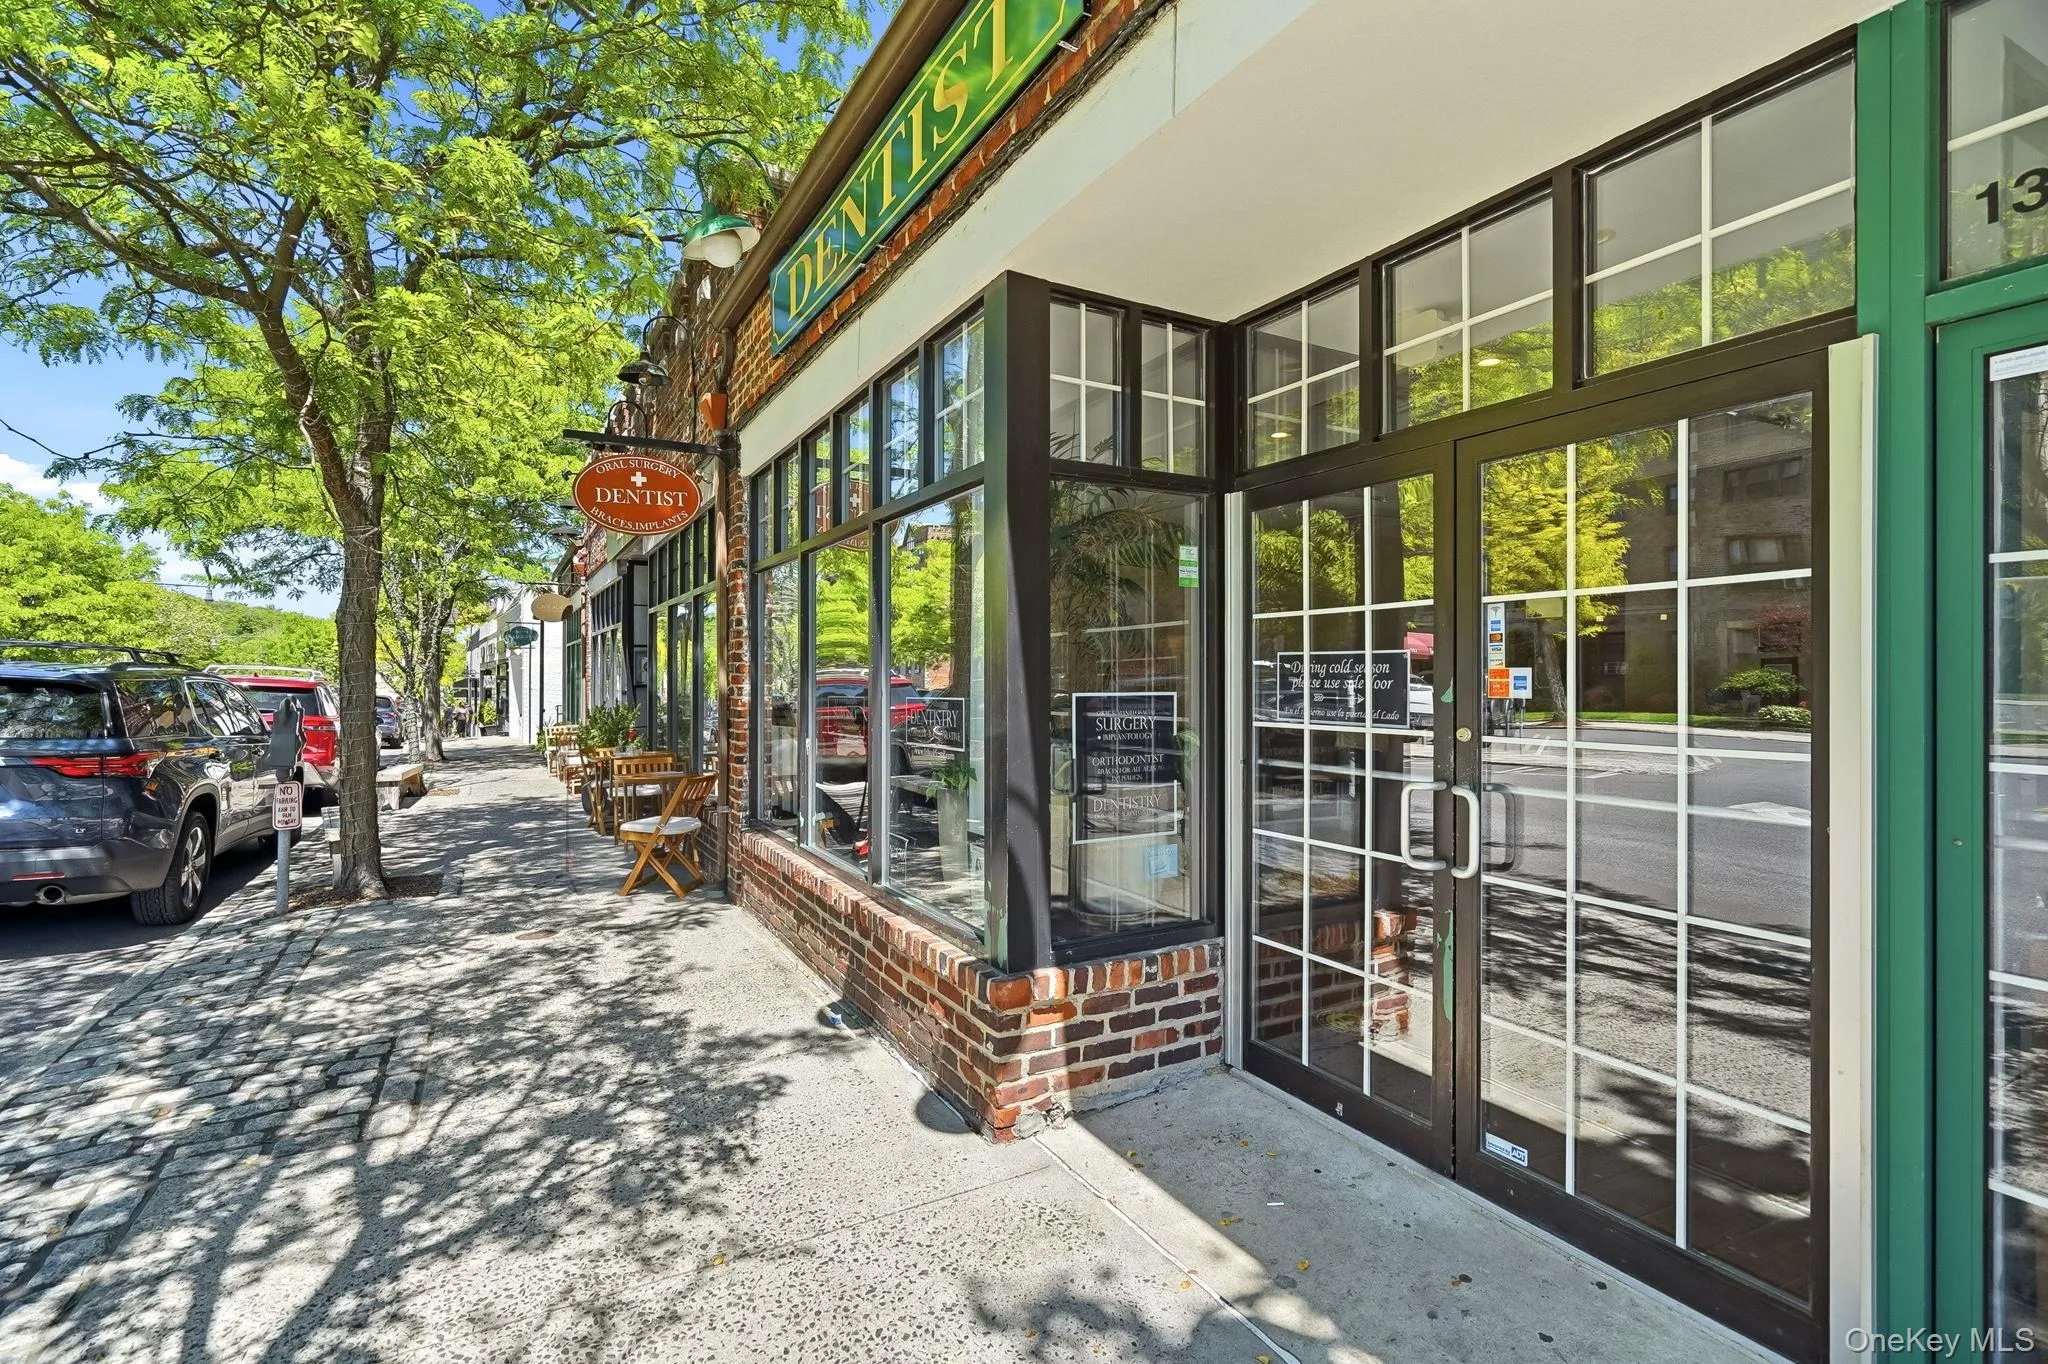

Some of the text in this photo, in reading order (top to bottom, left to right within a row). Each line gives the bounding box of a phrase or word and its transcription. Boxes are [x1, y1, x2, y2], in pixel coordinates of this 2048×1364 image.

[787, 0, 1014, 322] DENTIST
[1975, 166, 2048, 225] 13
[596, 459, 681, 480] ORAL SURGERY
[595, 487, 688, 507] DENTIST
[1291, 658, 1391, 678] Ding cold seson
[1291, 674, 1321, 692] plese
[1324, 679, 1341, 689] use
[910, 709, 959, 728] DENTISTRY
[1096, 716, 1157, 731] SURGERY
[1380, 710, 1400, 720] Lado
[1102, 732, 1155, 741] IMPLANTOLOGY
[1092, 754, 1165, 767] ORTHODONTIST
[280, 786, 293, 796] NO
[1093, 793, 1162, 812] DENTISTRY
